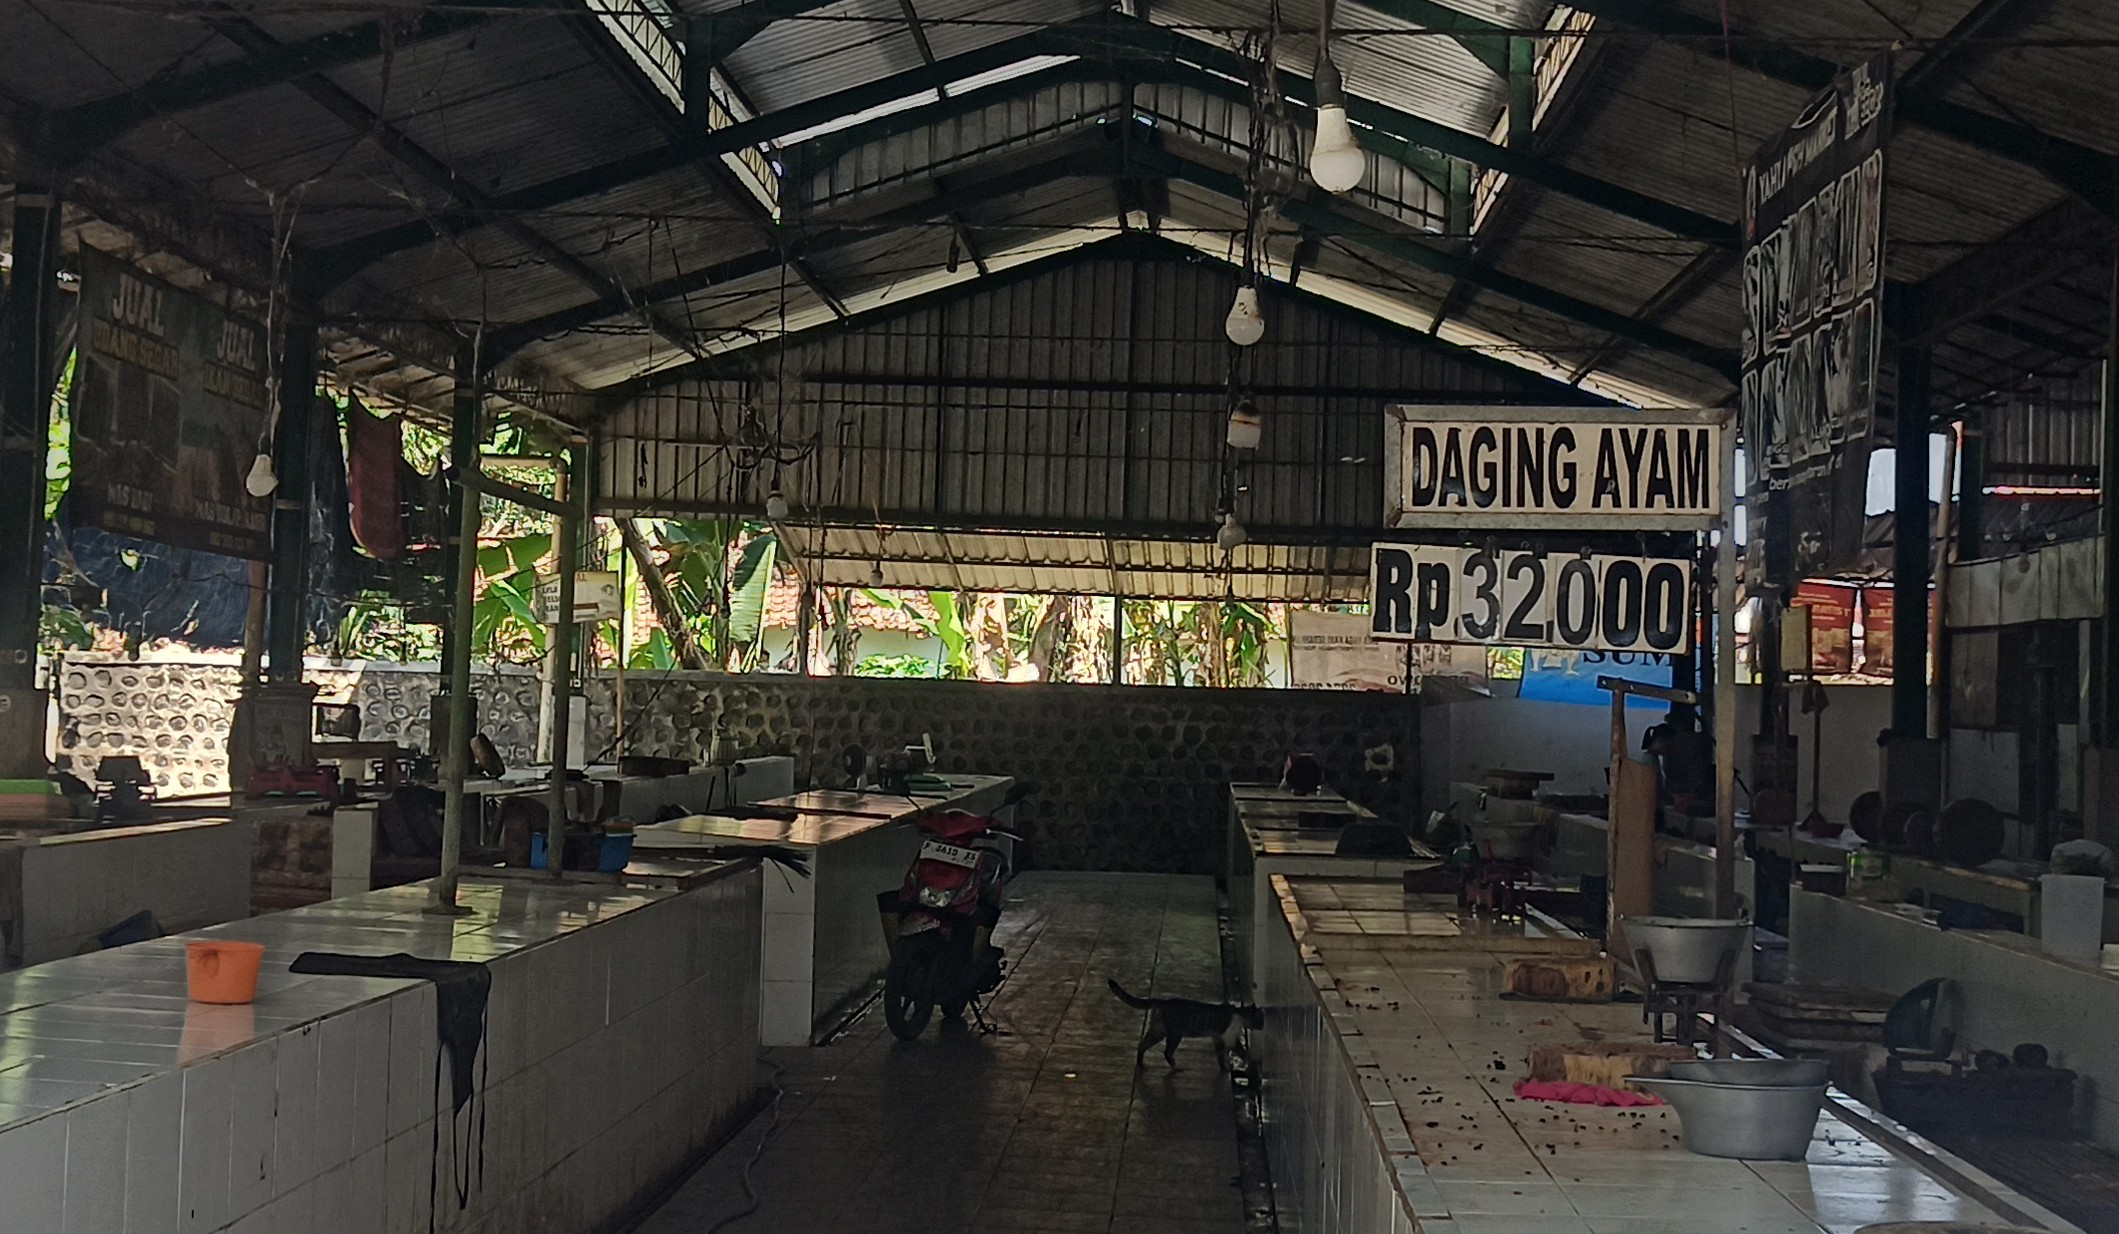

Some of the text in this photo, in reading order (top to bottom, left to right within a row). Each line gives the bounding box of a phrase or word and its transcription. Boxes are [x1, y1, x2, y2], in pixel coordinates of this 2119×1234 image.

[112, 273, 165, 337] JUAL
[216, 320, 256, 371] JUAL
[1411, 426, 1578, 509] DAGING
[1591, 428, 1711, 510] AYAM
